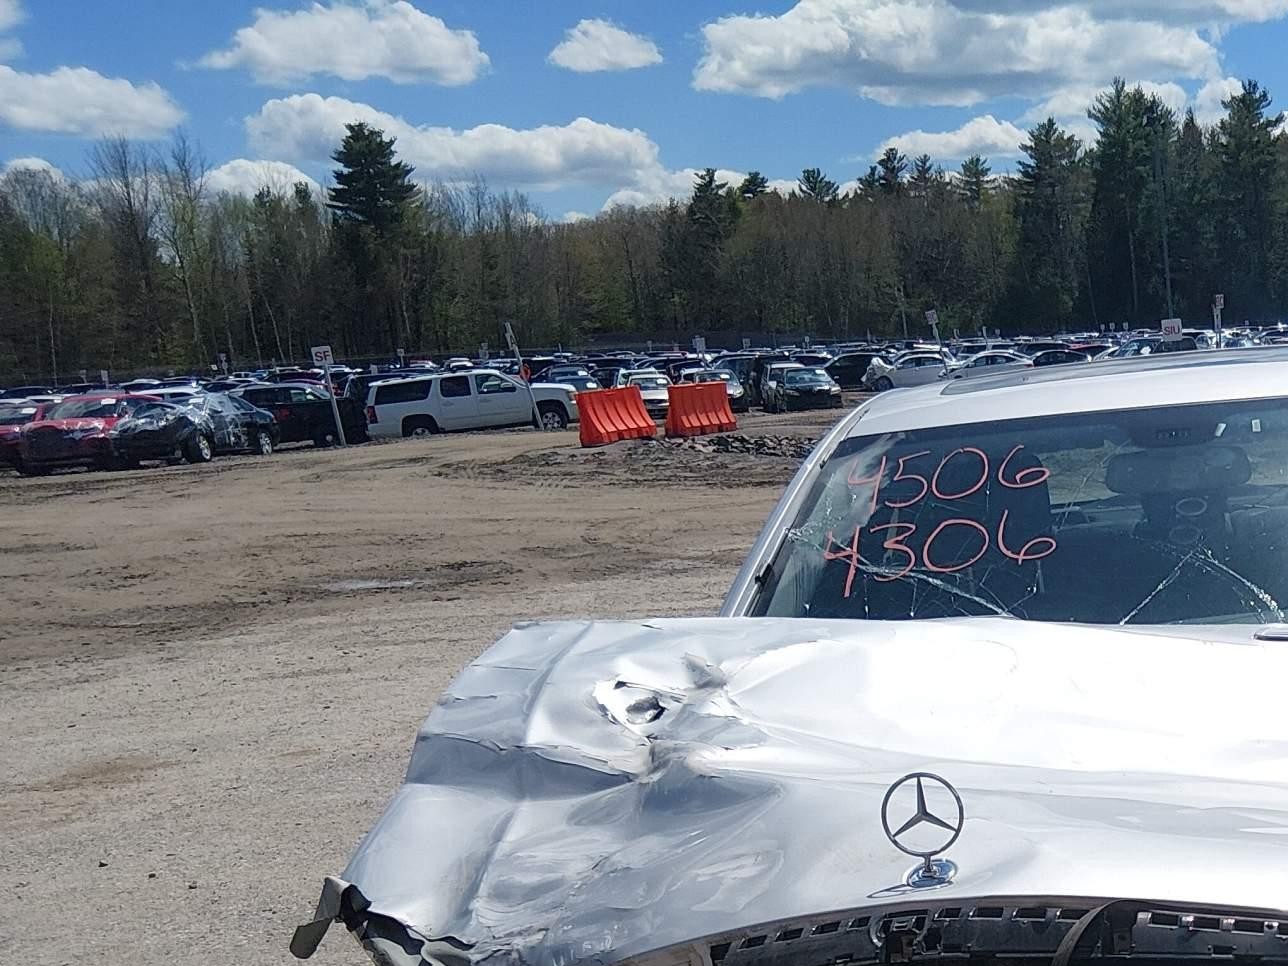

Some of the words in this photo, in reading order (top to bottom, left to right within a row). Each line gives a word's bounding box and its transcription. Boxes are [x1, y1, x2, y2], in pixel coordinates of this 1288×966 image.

[314, 351, 331, 361] SF
[847, 444, 1051, 514] 4506
[823, 509, 1057, 598] 4306
